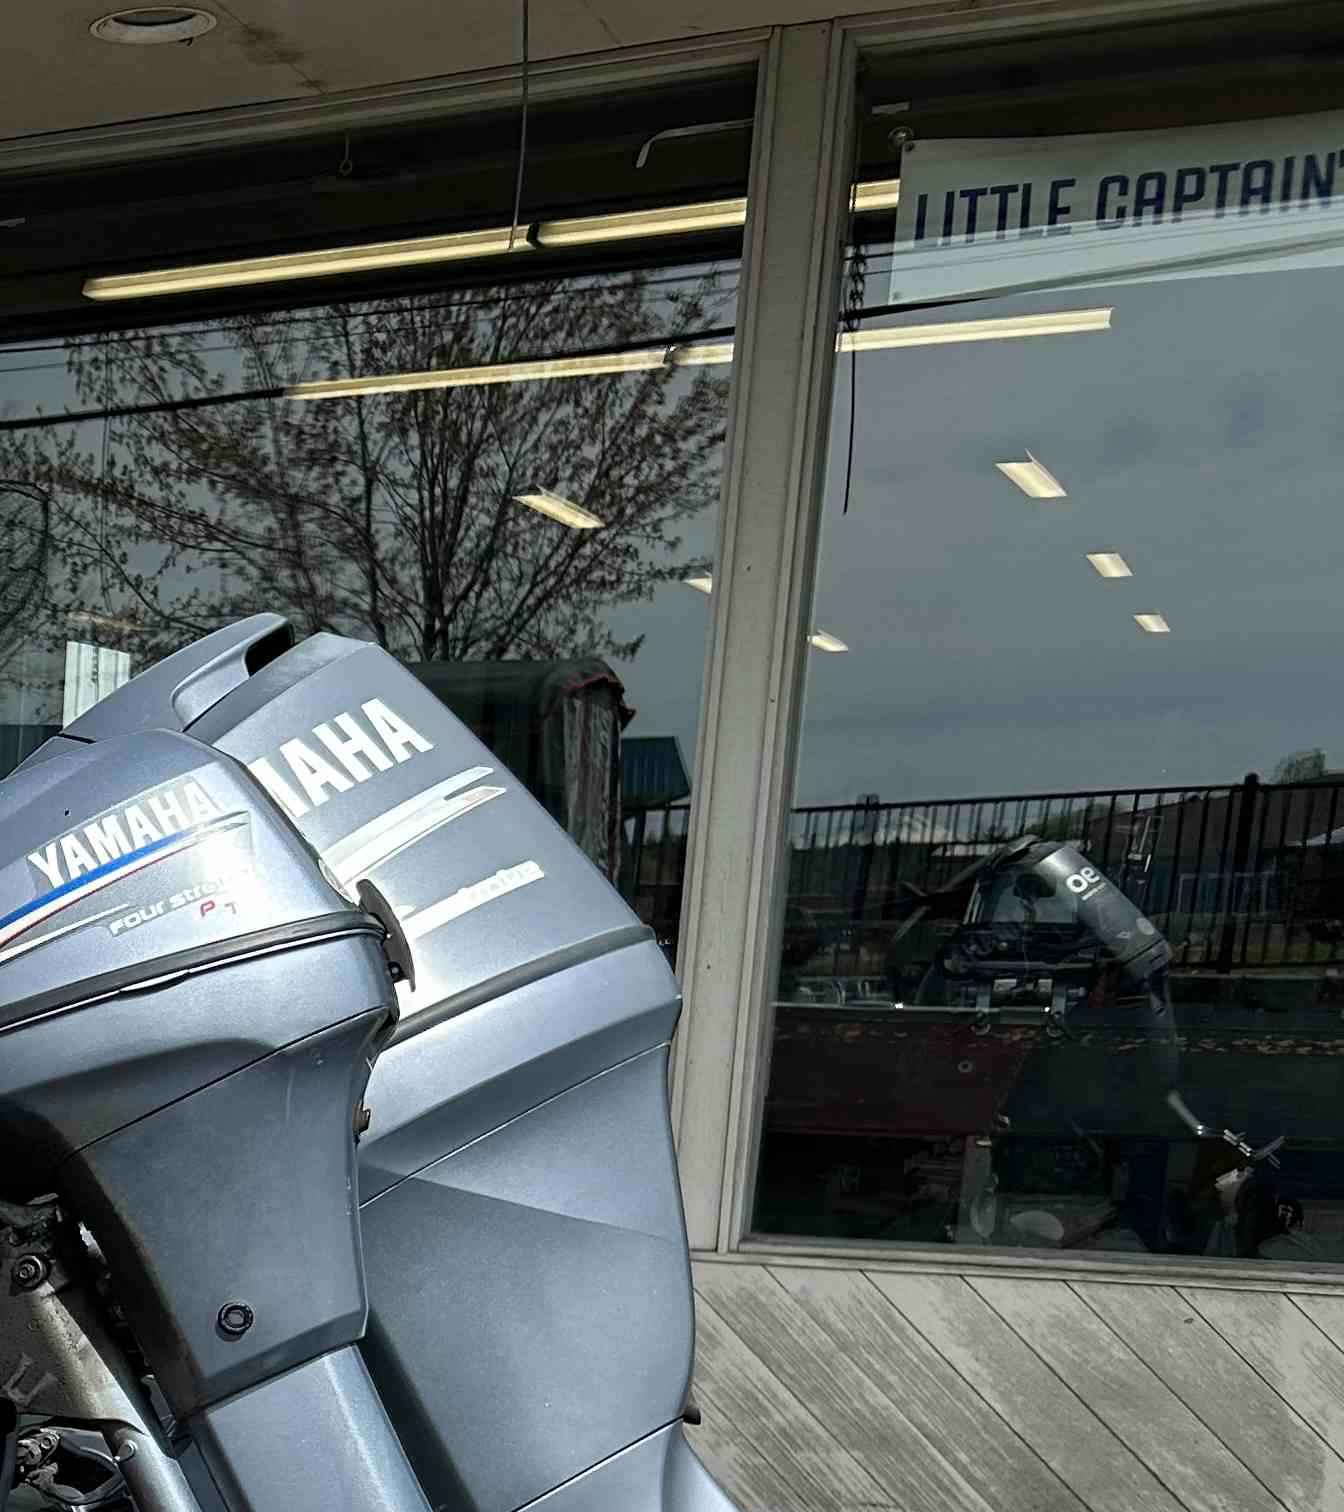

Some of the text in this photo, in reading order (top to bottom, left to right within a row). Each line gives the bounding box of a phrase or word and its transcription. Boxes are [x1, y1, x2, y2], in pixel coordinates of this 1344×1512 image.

[913, 178, 1076, 248] LITTLE
[248, 697, 435, 819] AHA
[27, 780, 222, 891] YAMAHA
